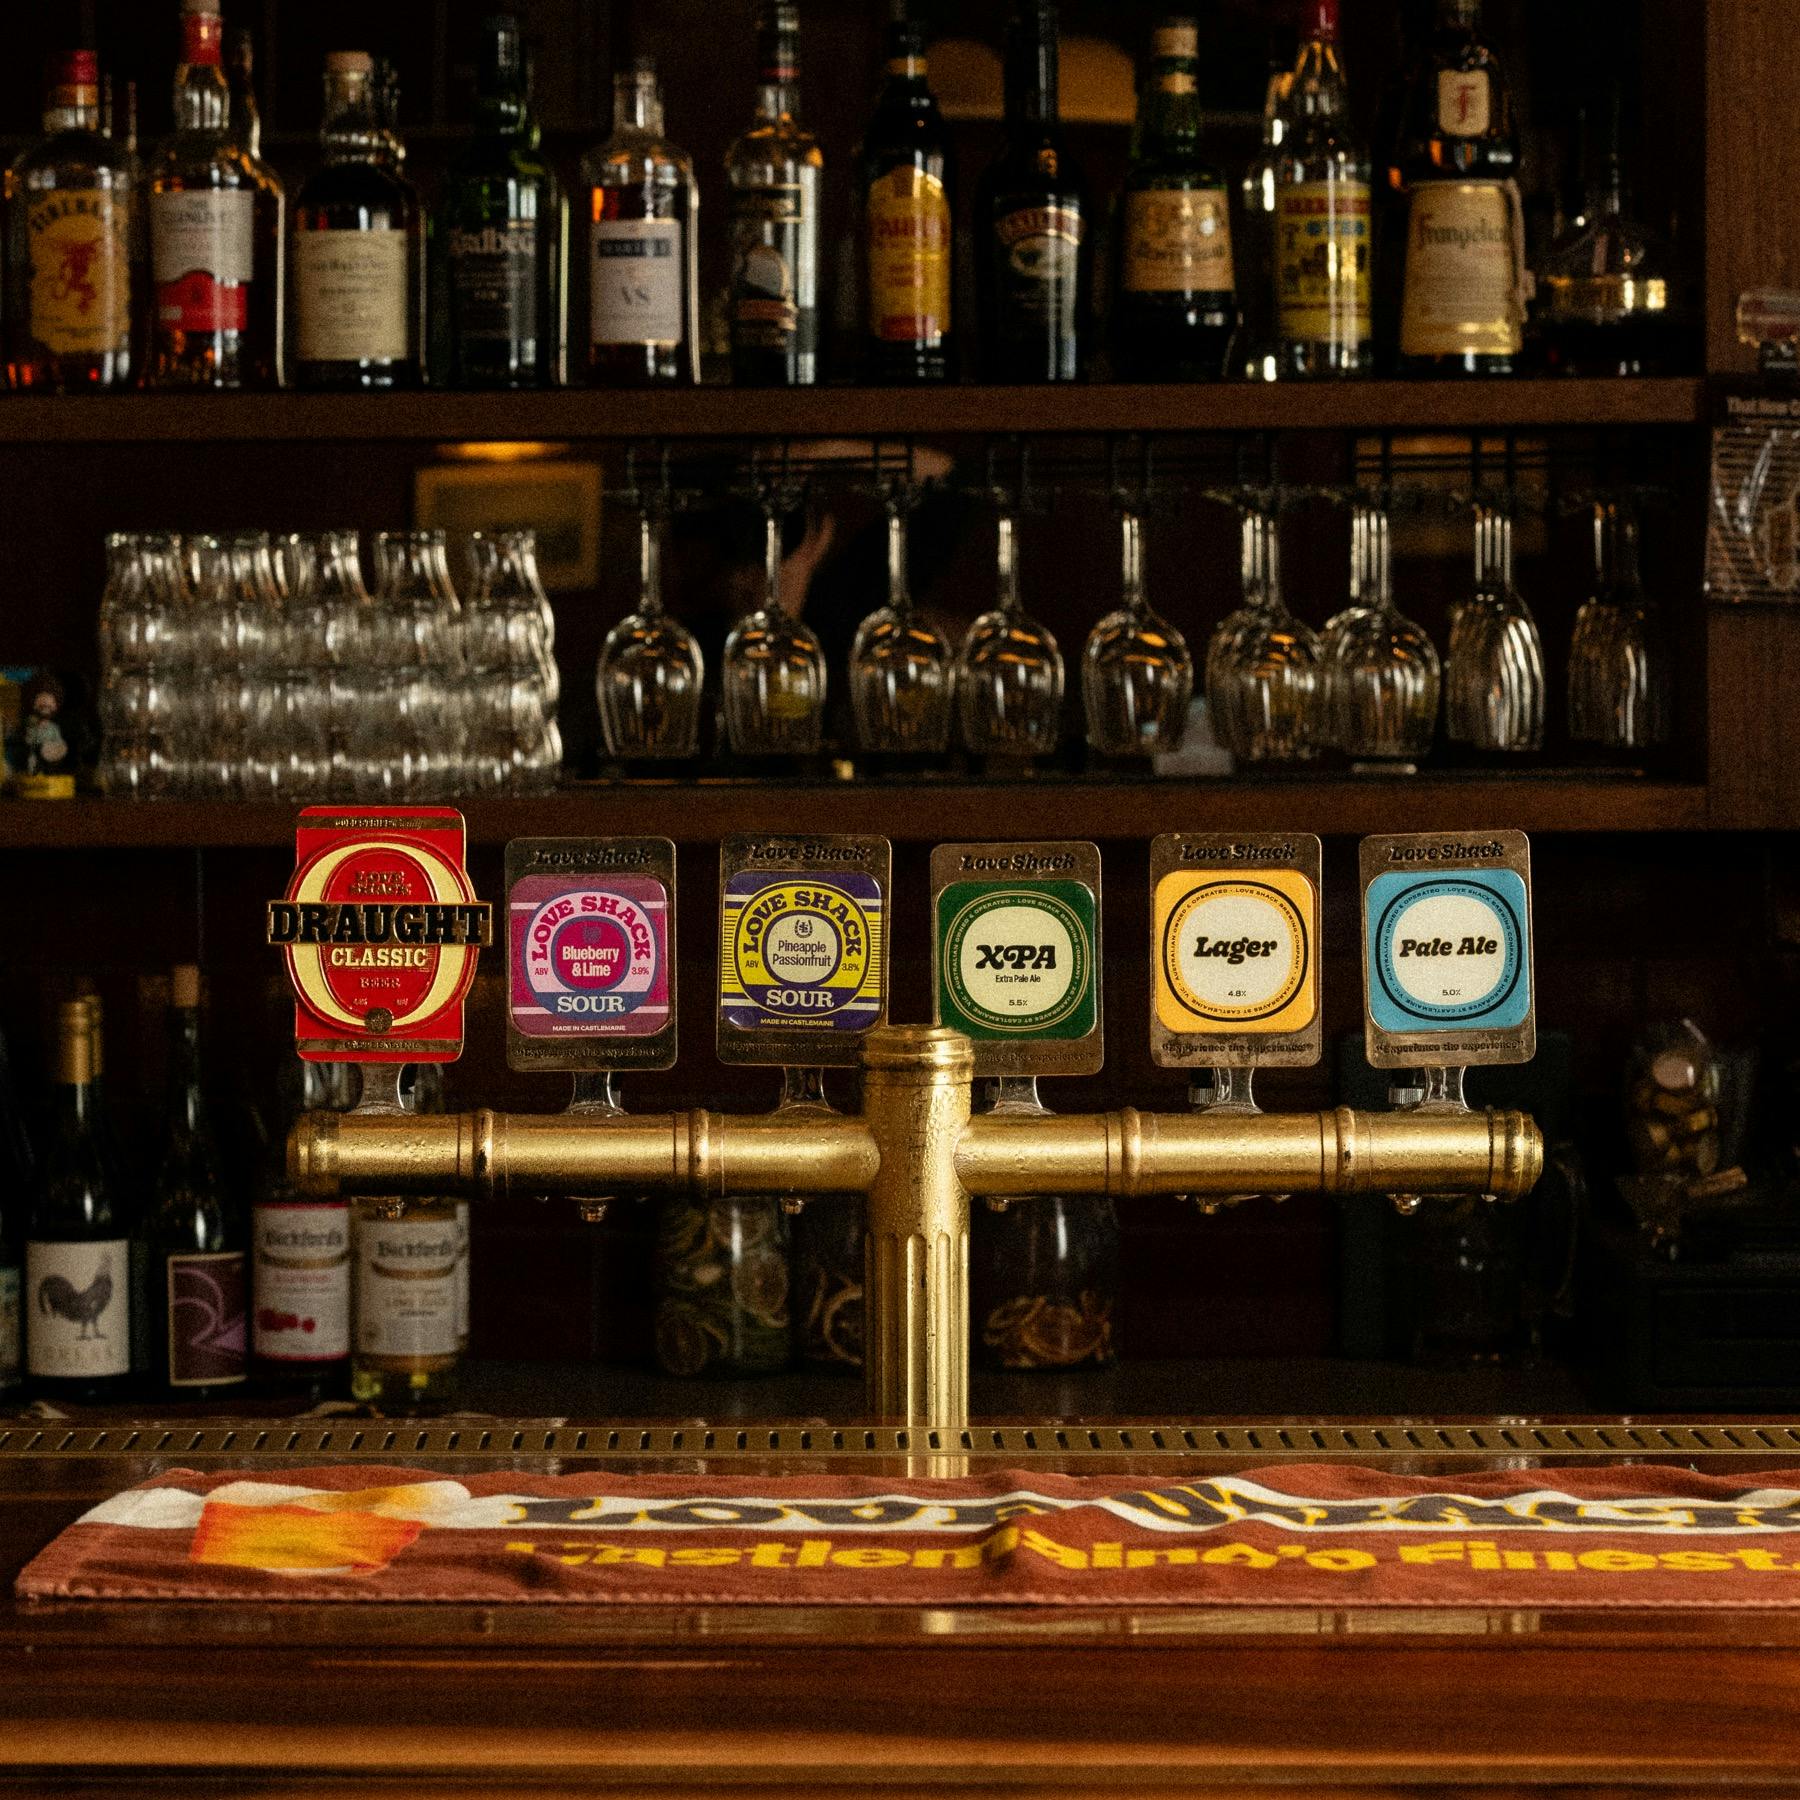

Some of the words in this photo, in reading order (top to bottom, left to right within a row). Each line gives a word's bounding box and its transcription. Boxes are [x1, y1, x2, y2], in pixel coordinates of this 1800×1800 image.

[1192, 889, 1228, 904] OPERATED
[1404, 888, 1440, 904] OPERATED
[955, 917, 970, 943] OWNED
[975, 898, 1011, 914] OPERATED
[1256, 890, 1278, 904] SHACK
[1279, 903, 1298, 933] BREWING
[270, 904, 490, 944] DRAUGHT
[532, 899, 574, 961] LOVE
[581, 896, 651, 960] SHACK
[743, 893, 787, 953] LOVE
[794, 891, 862, 956] SHACK
[1173, 909, 1187, 933] OWNED
[1386, 909, 1399, 933] OWNED
[1468, 889, 1491, 902] SHACK
[1491, 901, 1511, 931] BREWING
[1507, 931, 1515, 968] COMPANY
[562, 945, 620, 961] Blueberry
[778, 940, 826, 956] Pineapple
[1193, 936, 1278, 965] Lager
[1399, 938, 1452, 957] Pale
[1456, 936, 1498, 955] Ale
[331, 947, 428, 967] CLASSIC
[745, 961, 758, 969] ABV
[772, 953, 832, 967] Passionfruit
[975, 944, 1057, 970] XPA
[1171, 935, 1180, 981] AUSTRALIAN
[1384, 935, 1394, 981] AUSTRALIAN
[535, 968, 548, 976] ABV
[572, 962, 582, 977] &
[583, 962, 611, 977] Lime
[632, 967, 649, 976] 3.9%
[841, 963, 859, 972] 3.8%
[360, 977, 401, 989] BEER
[995, 974, 1013, 983] Extra
[1014, 974, 1028, 983] Pale
[1029, 974, 1041, 983] Ale
[766, 989, 834, 1008] SOUR
[1179, 987, 1189, 998] VIC
[1393, 987, 1404, 997] VIC
[1468, 984, 1506, 1012] HARGRAVES
[557, 996, 625, 1013] SOUR
[790, 1019, 834, 1027] CASTLEMAINE
